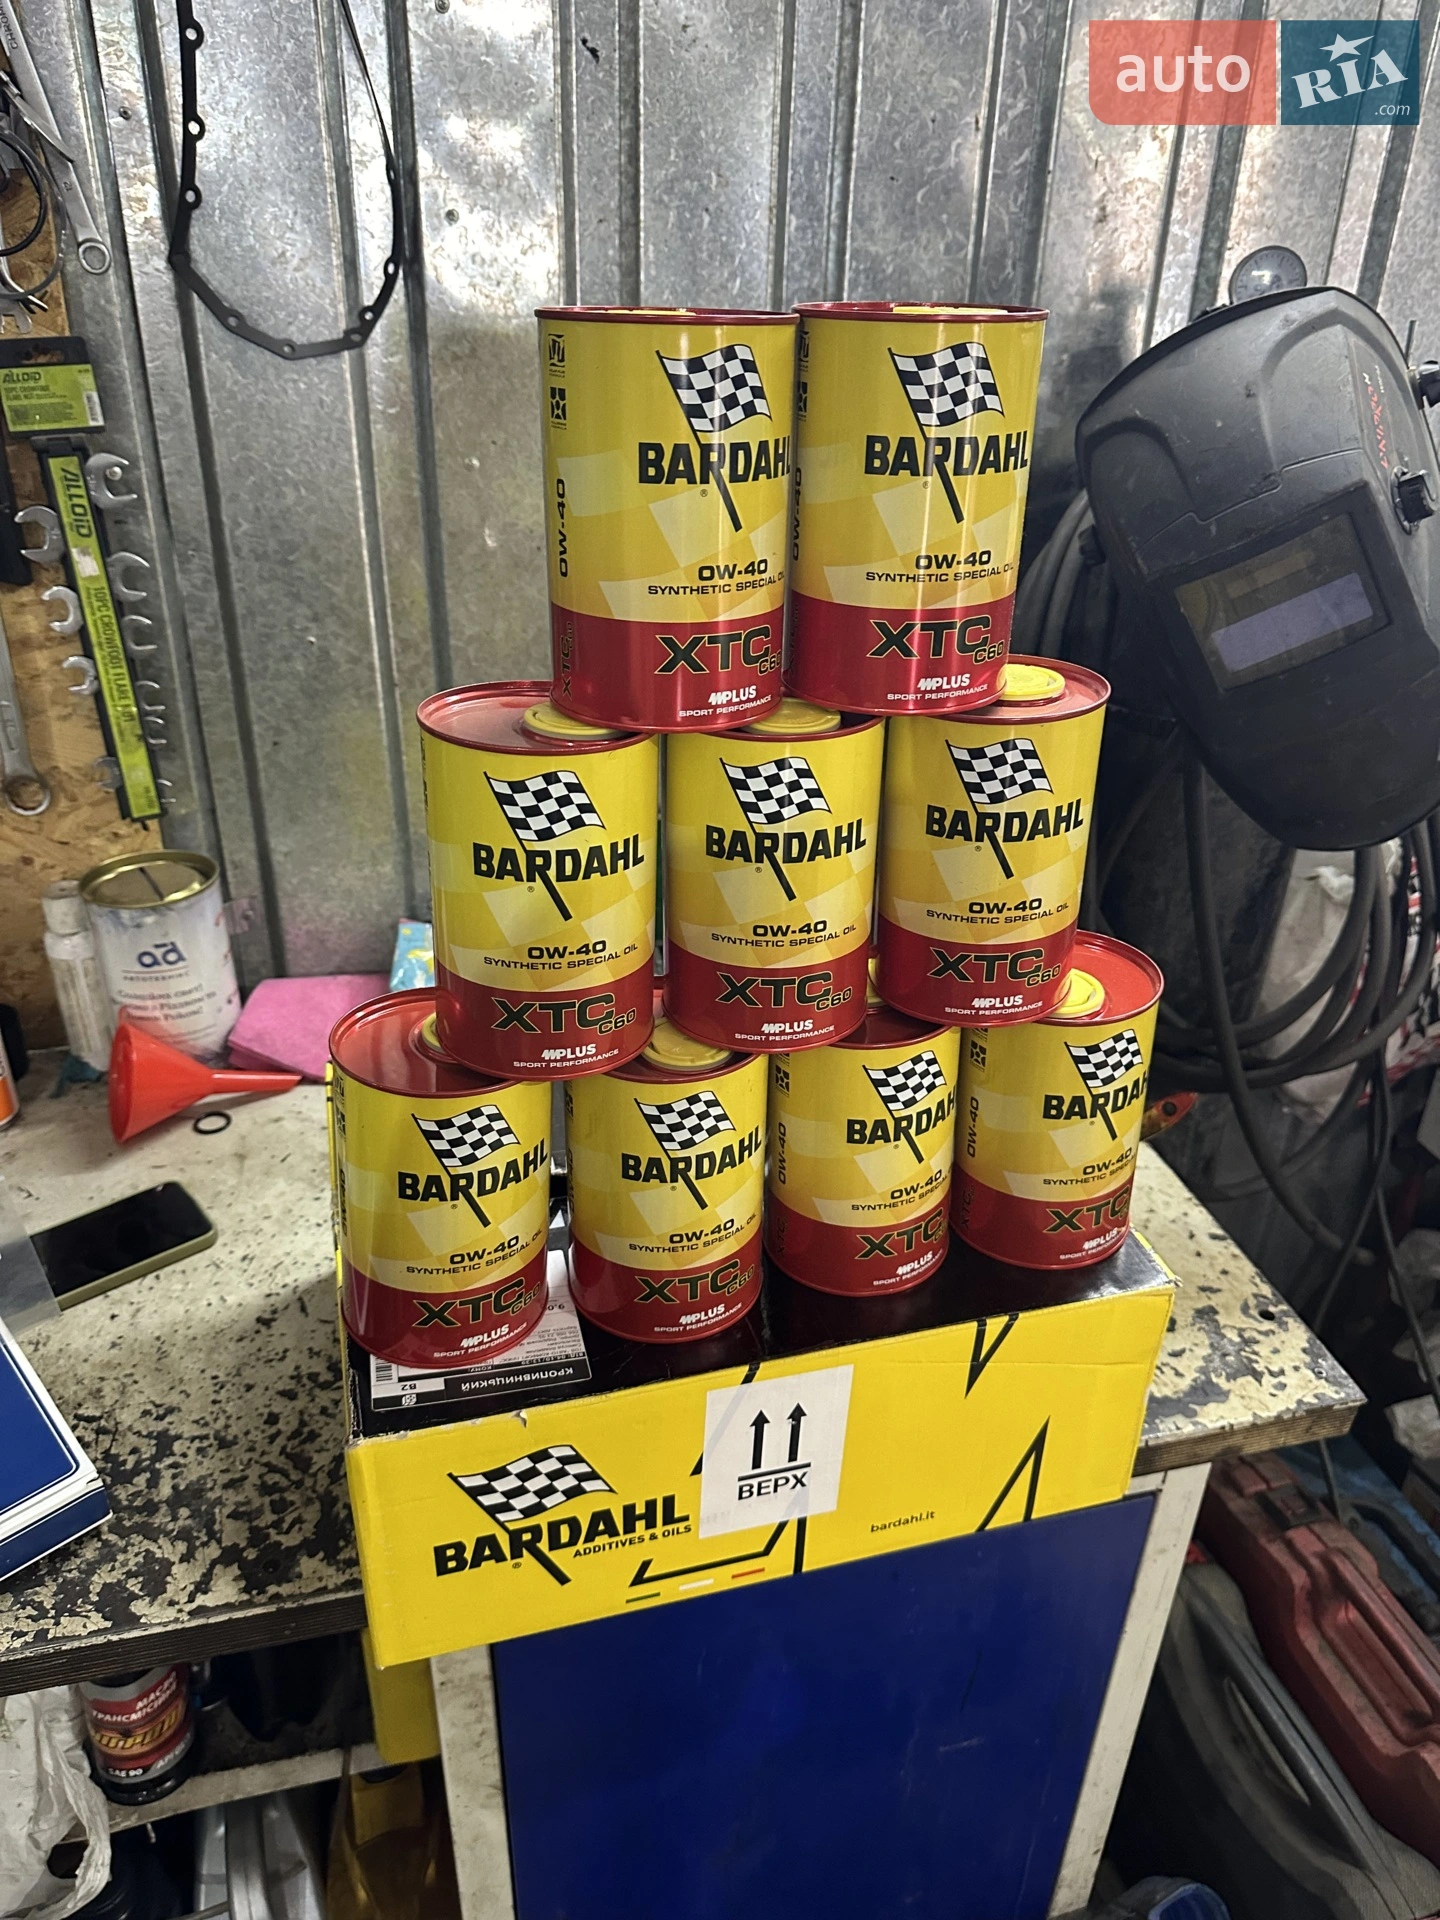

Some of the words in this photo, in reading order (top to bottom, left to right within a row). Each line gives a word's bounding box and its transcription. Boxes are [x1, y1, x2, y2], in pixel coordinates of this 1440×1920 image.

[638, 435, 790, 485] BARDAHL
[864, 430, 1028, 477] BARDAHL
[648, 584, 731, 595] SYNTHETIC
[736, 576, 777, 592] SPECIAL
[865, 571, 949, 582] SYNTHETIC
[953, 566, 1001, 581] SPECIAL
[654, 625, 771, 674] XTC
[867, 615, 992, 659] XTC
[973, 639, 1005, 665] C60
[679, 708, 714, 717] SPORT
[716, 694, 771, 714] PERFORMANCE
[925, 684, 988, 700] PERFORMANCE
[926, 797, 1085, 843] BARDAHL
[472, 833, 645, 883] BARDAHL
[705, 818, 867, 864] BARDAHL
[926, 908, 1000, 924] SYNTHETIC
[1004, 906, 1054, 924] SPECIAL
[1056, 901, 1070, 913] OIL
[711, 932, 785, 948] SYNTHETIC
[789, 929, 841, 948] SPECIAL
[842, 923, 857, 935] OIL
[483, 955, 562, 970] SYNTHETIC
[567, 952, 621, 969] SPECIAL
[623, 942, 639, 955] OIL
[928, 946, 1044, 984] XTC
[1026, 961, 1062, 987] C60
[715, 970, 833, 1008] XTC
[814, 986, 853, 1013] C60
[944, 1006, 977, 1015] SPORT
[978, 1001, 1043, 1016] PERFORMANCE
[490, 992, 616, 1035] XTC
[597, 1007, 637, 1036] C60
[734, 1033, 766, 1041] SPORT
[768, 1024, 835, 1041] PERFORMANCE
[513, 1060, 547, 1068] SPORT
[550, 1048, 620, 1067] PERFORMANCE
[846, 1084, 956, 1145] BARDAH
[397, 1137, 549, 1202] BARDAHL
[621, 1125, 762, 1184] BARDAHL
[1042, 1172, 1107, 1185] SYNTHETIC
[851, 1196, 916, 1211] SYNTHETIC
[1042, 1185, 1131, 1234] XTC
[405, 1263, 481, 1275] SYNTHETIC
[485, 1239, 531, 1268] SPECIAL
[531, 1228, 543, 1244] OIL
[628, 1243, 699, 1253] SYNTHETIC
[703, 1225, 745, 1248] SPECIAL
[746, 1213, 757, 1226] OIL
[854, 1207, 944, 1259] XTC
[1059, 1251, 1087, 1260] SPORT
[635, 1258, 740, 1304] XTC
[724, 1263, 755, 1296] C60
[873, 1276, 901, 1286] SPORT
[412, 1276, 525, 1328] XTC
[509, 1281, 541, 1316] C60
[686, 1302, 742, 1333] PERFORMANCE
[433, 1349, 466, 1359] SPORT
[467, 1321, 528, 1357] PERFORMANCE
[461, 1366, 574, 1392] КРОПИВНИЦЬКИЙ
[737, 1471, 808, 1500] ВЕРХ
[433, 1493, 690, 1577] BARDAHL
[870, 1509, 936, 1533] bardahl.it
[573, 1534, 646, 1558] ADDITIVES
[649, 1532, 658, 1541] &
[662, 1524, 692, 1538] OILS
